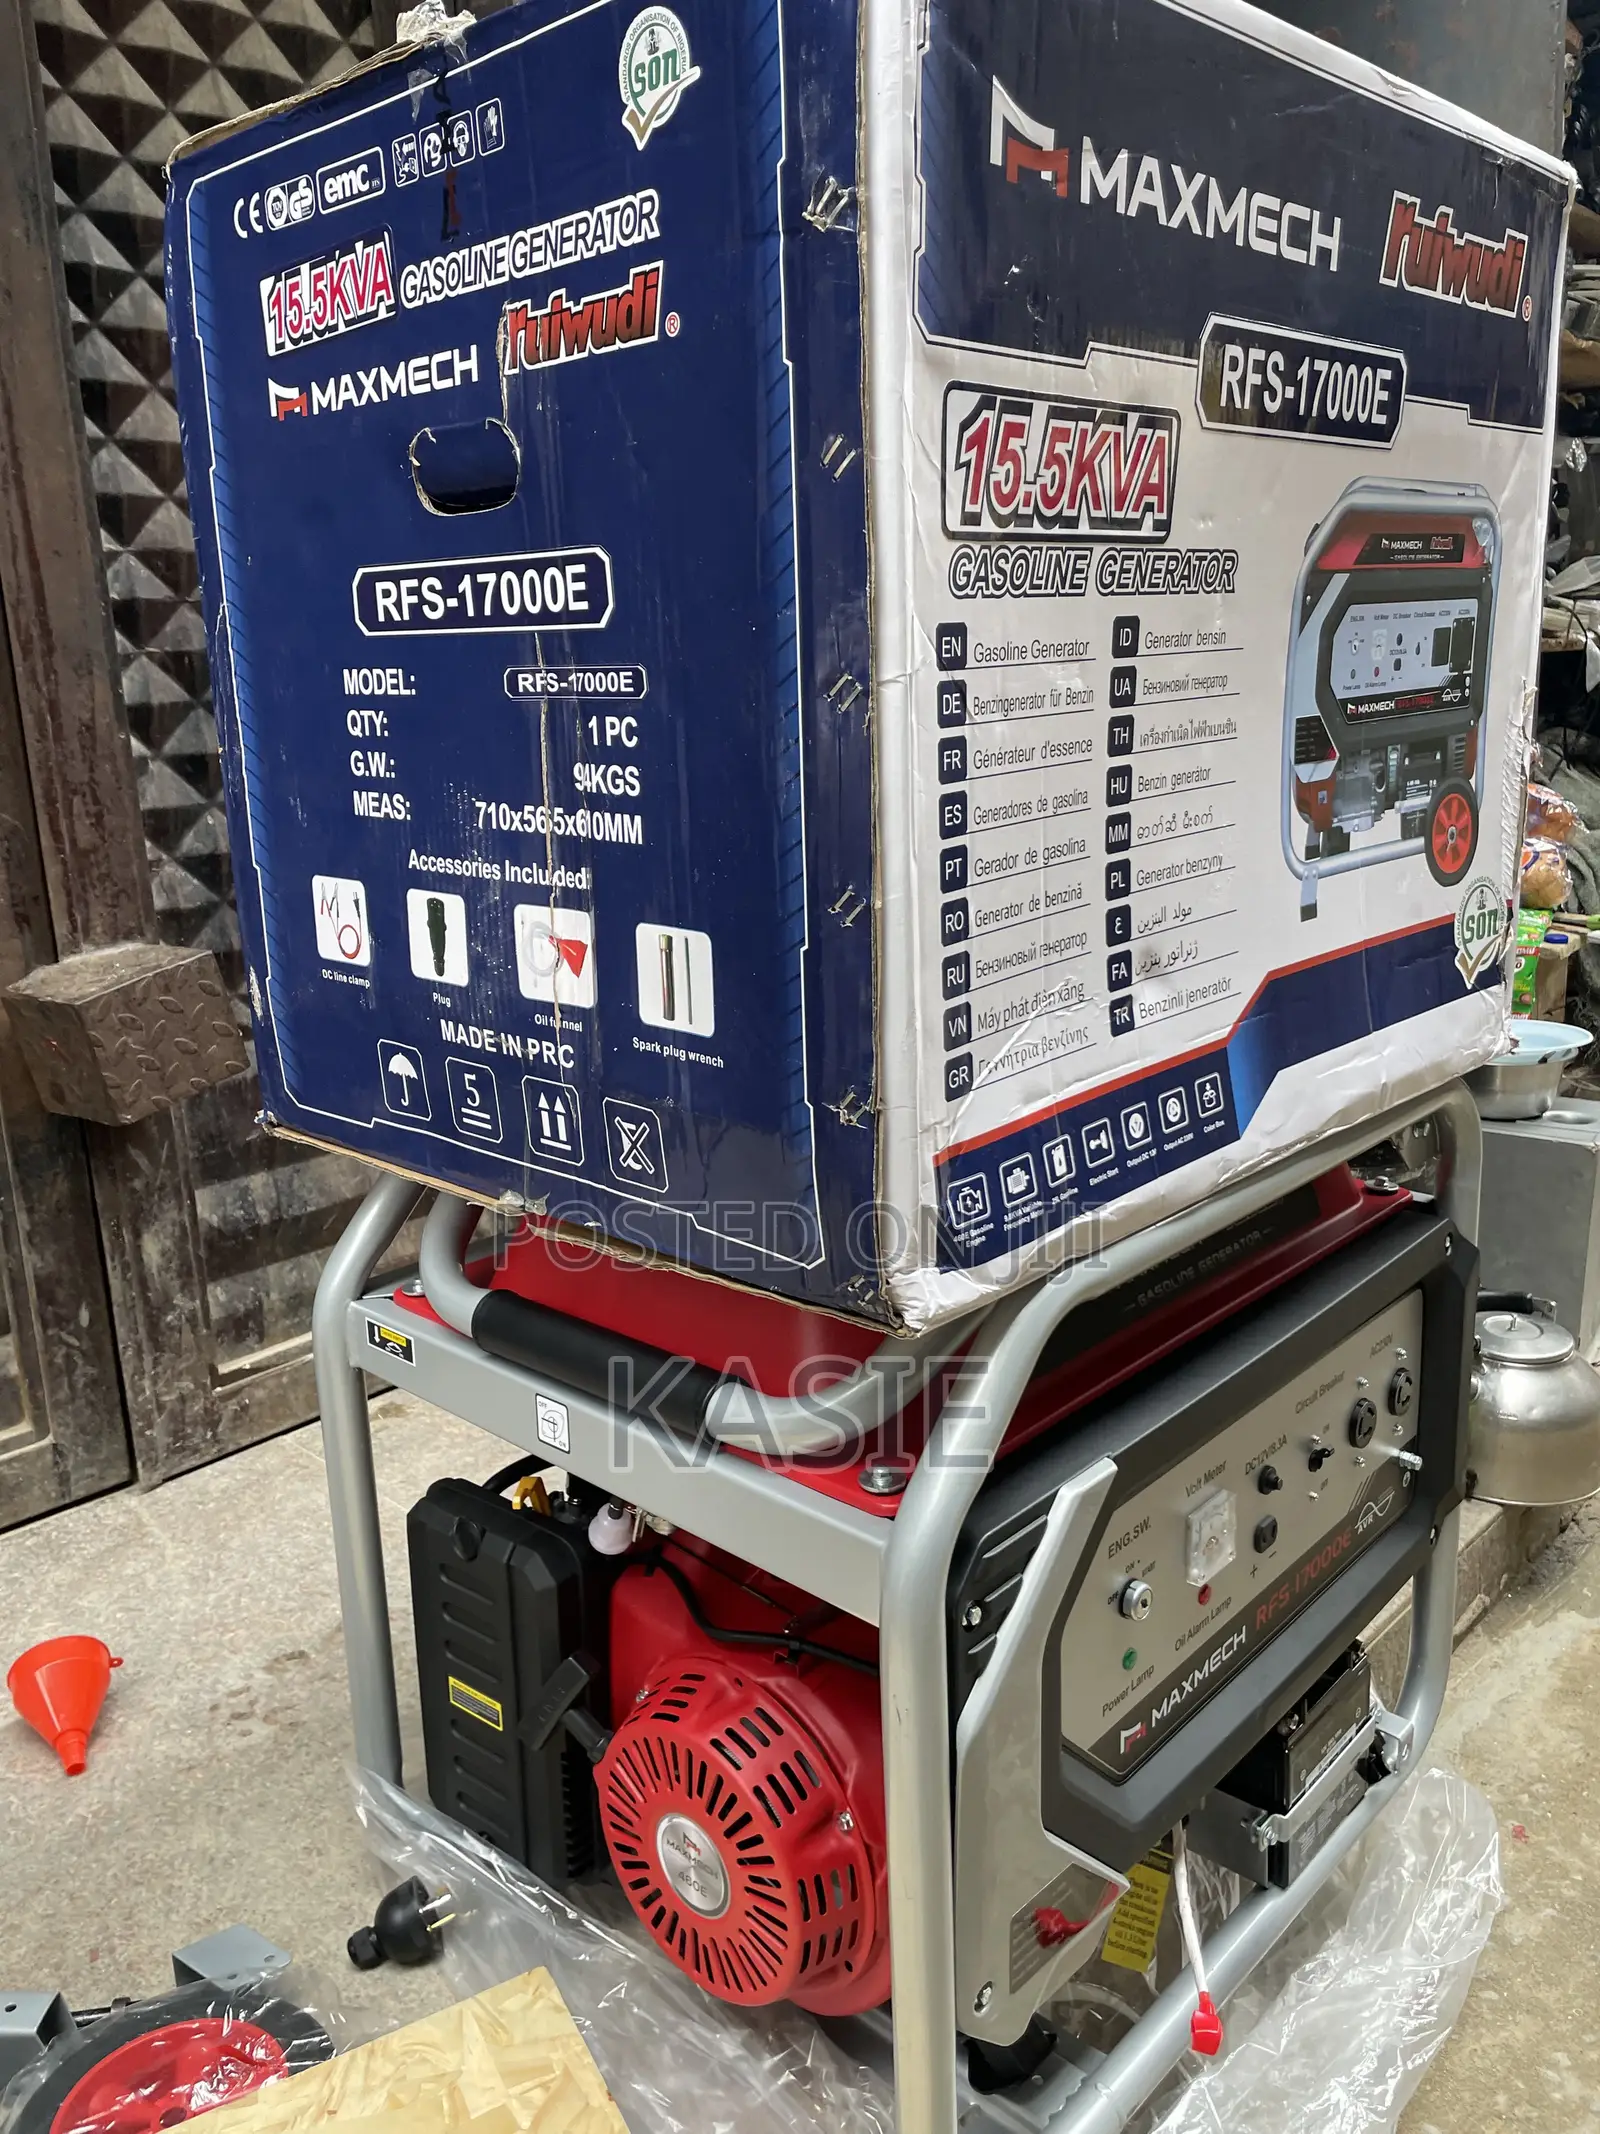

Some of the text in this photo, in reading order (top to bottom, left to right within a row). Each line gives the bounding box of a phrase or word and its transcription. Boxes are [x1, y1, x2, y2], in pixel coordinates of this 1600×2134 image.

[621, 12, 687, 103] STANDARDS ORGANISATION OF NIGERIA
[324, 163, 370, 204] emc
[233, 191, 264, 239] CE
[1079, 136, 1343, 274] MAXMECH
[401, 189, 661, 309] GASOLINE GENERATOR
[269, 240, 396, 346] 15.5KVA
[310, 344, 479, 416] MAXMECH
[1219, 344, 1392, 426] RFS-17000E
[956, 398, 1173, 526] 15.5KVA
[949, 543, 1240, 599] GASOLINE GENERATOR
[375, 563, 589, 622] RFS-17000E
[942, 636, 961, 658] EN
[973, 639, 1090, 663] Gasoline Generator
[1119, 628, 1132, 647] ID
[1144, 628, 1226, 650] Generator bensin
[342, 668, 416, 695] MODEL:
[517, 671, 634, 693] RFS-17000E
[1114, 677, 1131, 696] UA
[1142, 674, 1228, 696] Бензиновий генератор
[942, 693, 961, 715] DE
[973, 686, 1094, 717] Benzingenerator für Benzin
[1357, 700, 1395, 713] MAXMECH
[346, 709, 389, 738] QTY:
[588, 715, 639, 748] 1 PC
[1113, 727, 1130, 746] TH
[350, 750, 396, 779] G.W.:
[943, 749, 962, 771] FR
[973, 739, 1093, 770] Générateur d'essence
[1110, 776, 1128, 796] HU
[1137, 773, 1167, 793] Benzin
[352, 790, 412, 821] MEAS:
[944, 803, 962, 827] ES
[973, 788, 1088, 825] Generadores de gasolina
[1108, 822, 1128, 844] MM
[408, 849, 501, 881] Accessories
[945, 857, 963, 881] PT
[974, 837, 1086, 877] Gerador de gasolina
[1136, 854, 1224, 886] Generator benzyny
[1110, 871, 1126, 890] PL
[944, 910, 964, 934] RO
[974, 902, 1023, 928] Generator
[1028, 894, 1041, 913] de
[975, 931, 1088, 980] Бензиновый генератор
[348, 975, 371, 990] clamp
[946, 963, 965, 988] RU
[1111, 961, 1128, 982] FA
[432, 992, 451, 1008] Plug
[977, 1003, 1001, 1033] Máy
[1003, 992, 1029, 1025] phát
[1138, 978, 1232, 1019] Benzinli jeneratör
[534, 1013, 548, 1026] Oil
[948, 1014, 967, 1038] VN
[1113, 1006, 1131, 1026] TR
[440, 1019, 575, 1069] MADE IN PRC
[632, 1036, 724, 1069] Spark plug wrench
[948, 1065, 969, 1089] GR
[1215, 1119, 1226, 1129] Box
[1089, 1167, 1120, 1187] Electric Start
[965, 1234, 987, 1248] Engine
[969, 1222, 995, 1238] Gasoline
[1185, 1460, 1227, 1497] Volt Meter
[1107, 1516, 1152, 1559] ENG.SW.
[1357, 1514, 1374, 1535] AVR
[1151, 1530, 1353, 1728] MAXMECH RFS-17000E
[1174, 1595, 1233, 1652] Oil Alarm Lamp
[1101, 1664, 1155, 1717] Power Lamp
[666, 1837, 719, 1880] MAXMECH
